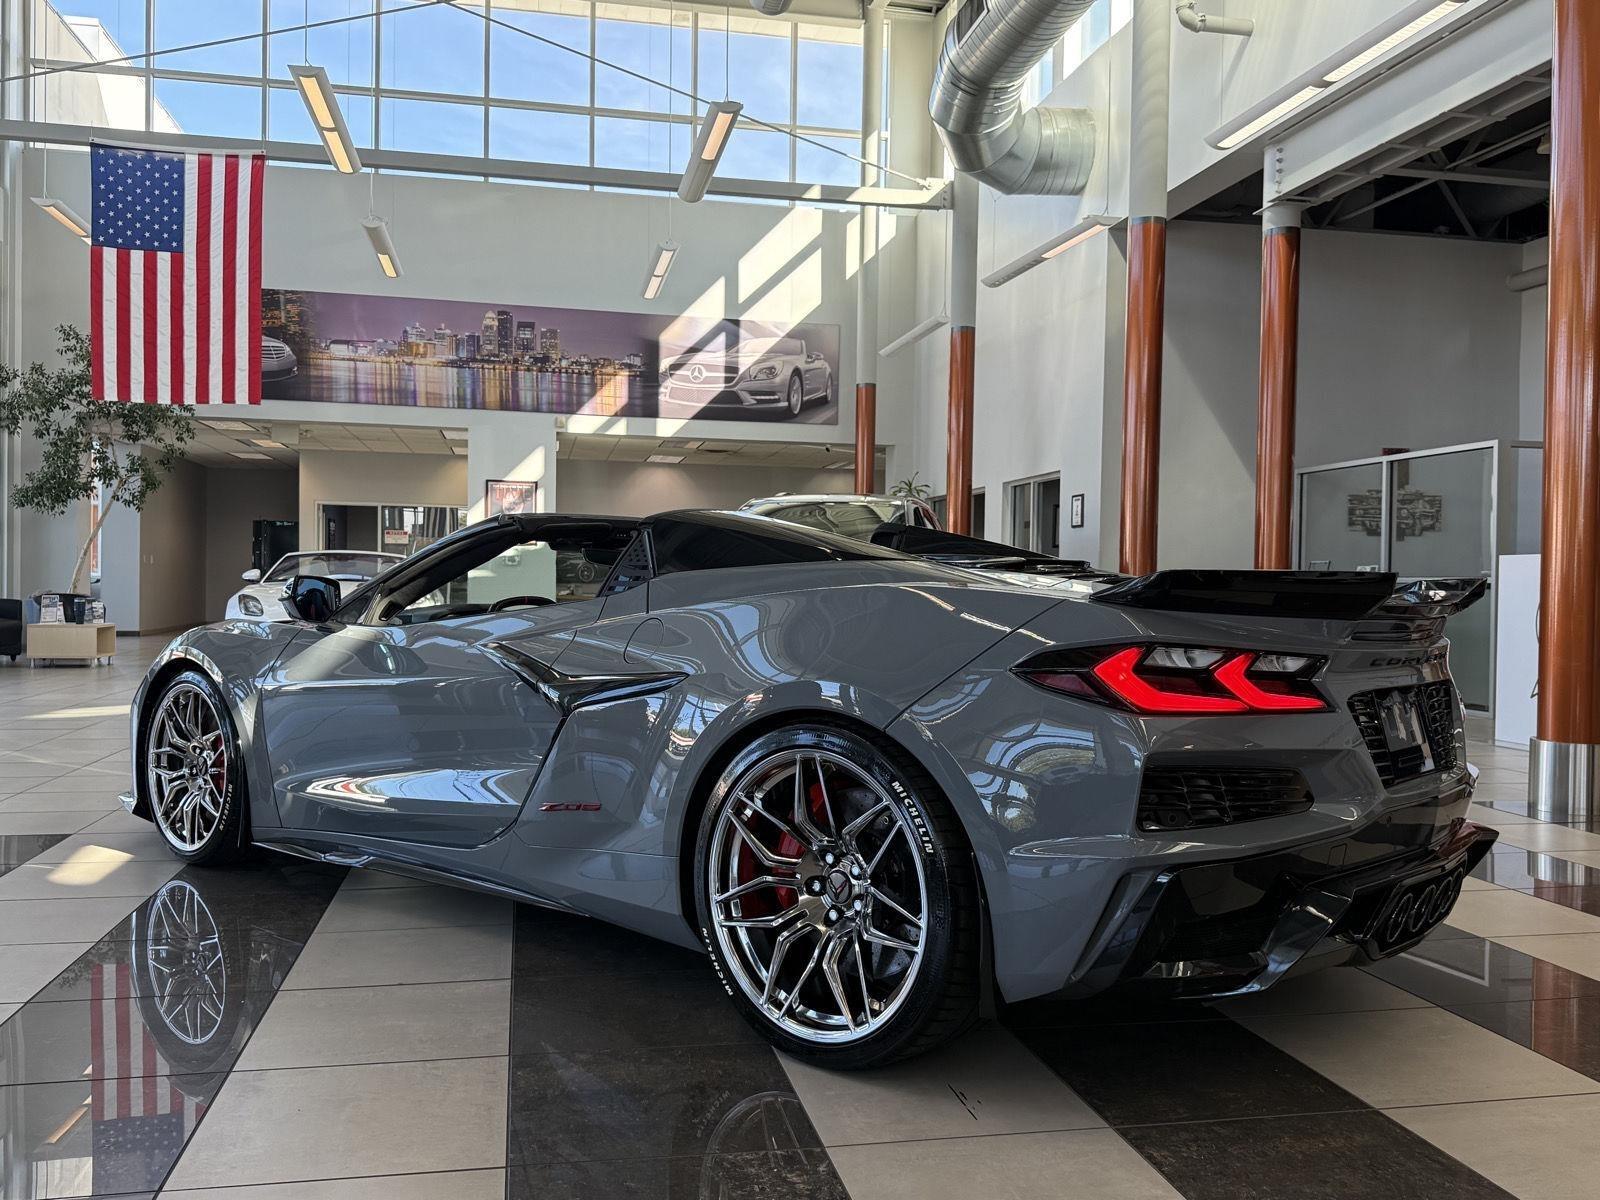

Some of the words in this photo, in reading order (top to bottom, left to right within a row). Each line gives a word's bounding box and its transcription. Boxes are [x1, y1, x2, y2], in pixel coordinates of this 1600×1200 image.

[219, 783, 233, 832] MICHELIN
[538, 802, 602, 812] Z06
[891, 780, 934, 854] MICHELIN
[702, 927, 734, 996] MICHELIN
